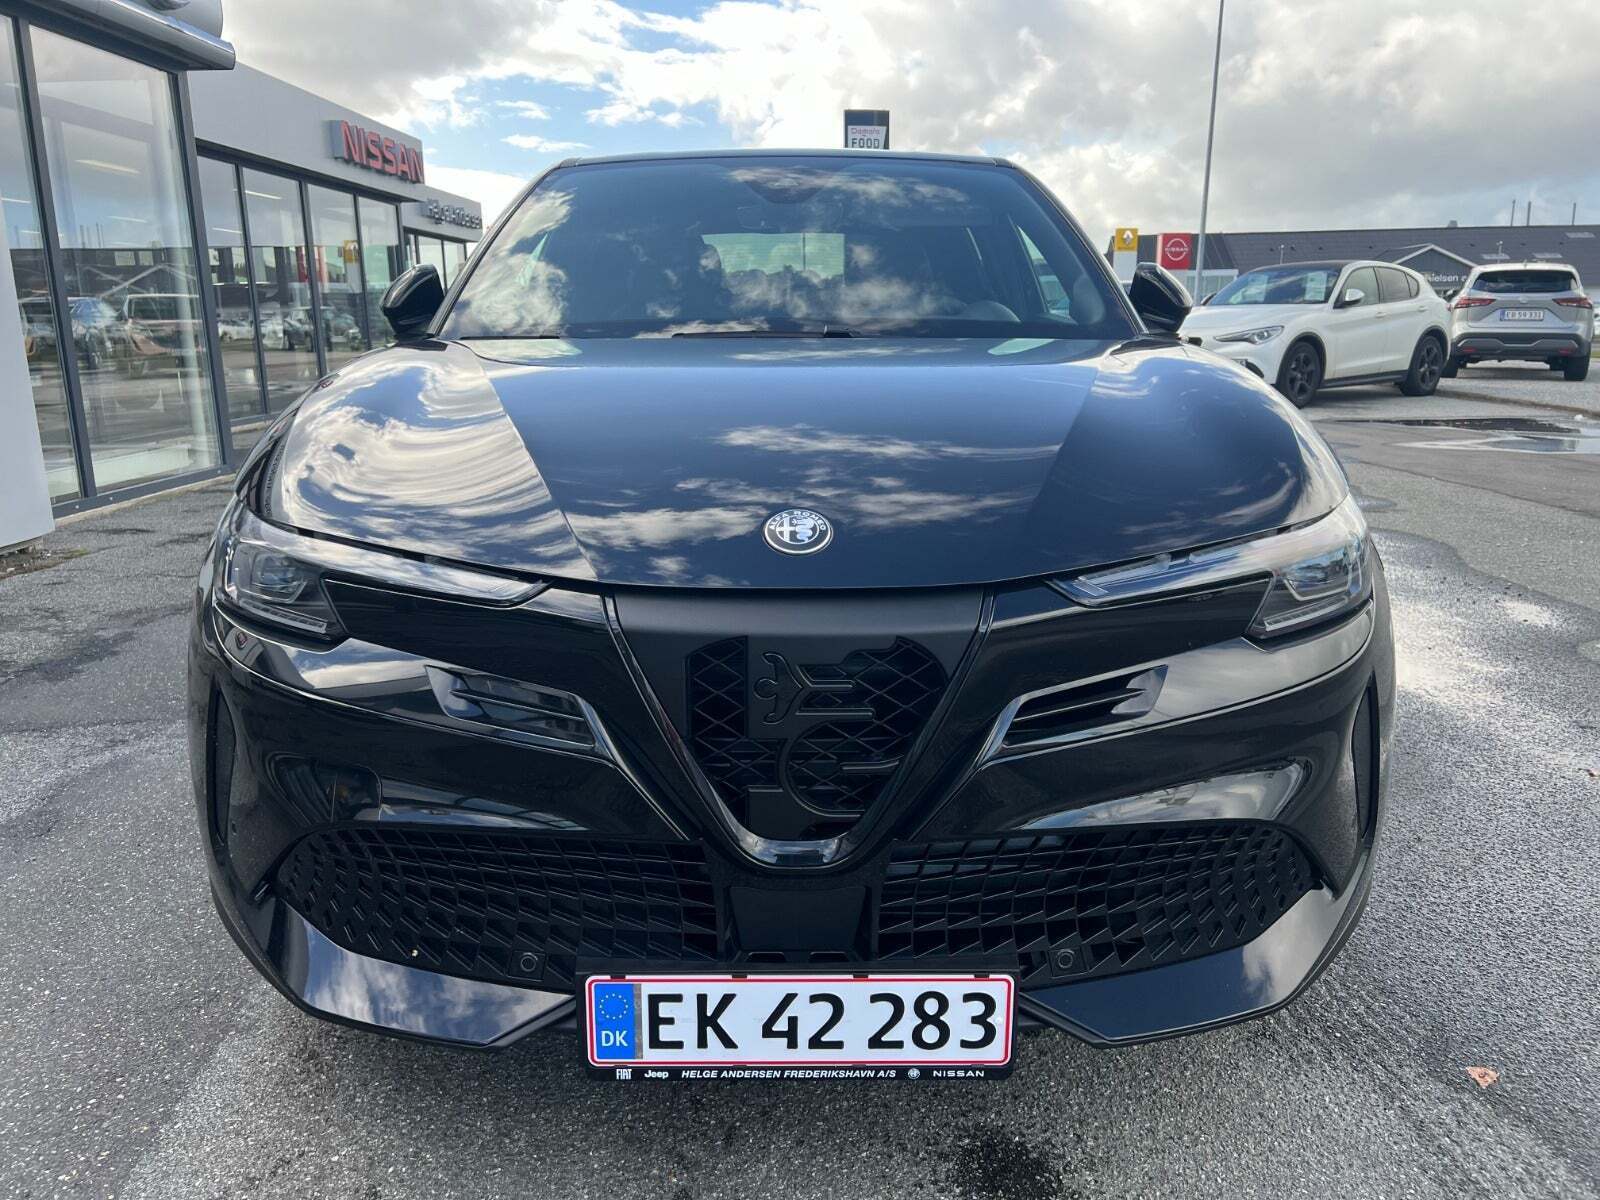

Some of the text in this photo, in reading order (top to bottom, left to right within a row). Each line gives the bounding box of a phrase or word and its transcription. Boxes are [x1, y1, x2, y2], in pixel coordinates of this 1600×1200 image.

[851, 137, 880, 149] FOOD
[340, 120, 424, 184] NISSAN
[768, 510, 827, 531] ALFA ROMEO
[647, 991, 998, 1051] EK 42 283
[601, 1030, 628, 1047] DK
[616, 1068, 632, 1080] FIAT
[644, 1070, 669, 1080] Jeep
[681, 1070, 897, 1079] HELGE ANDERSEN FREDERIKSHAVN A/S
[933, 1070, 985, 1078] NISSAN
